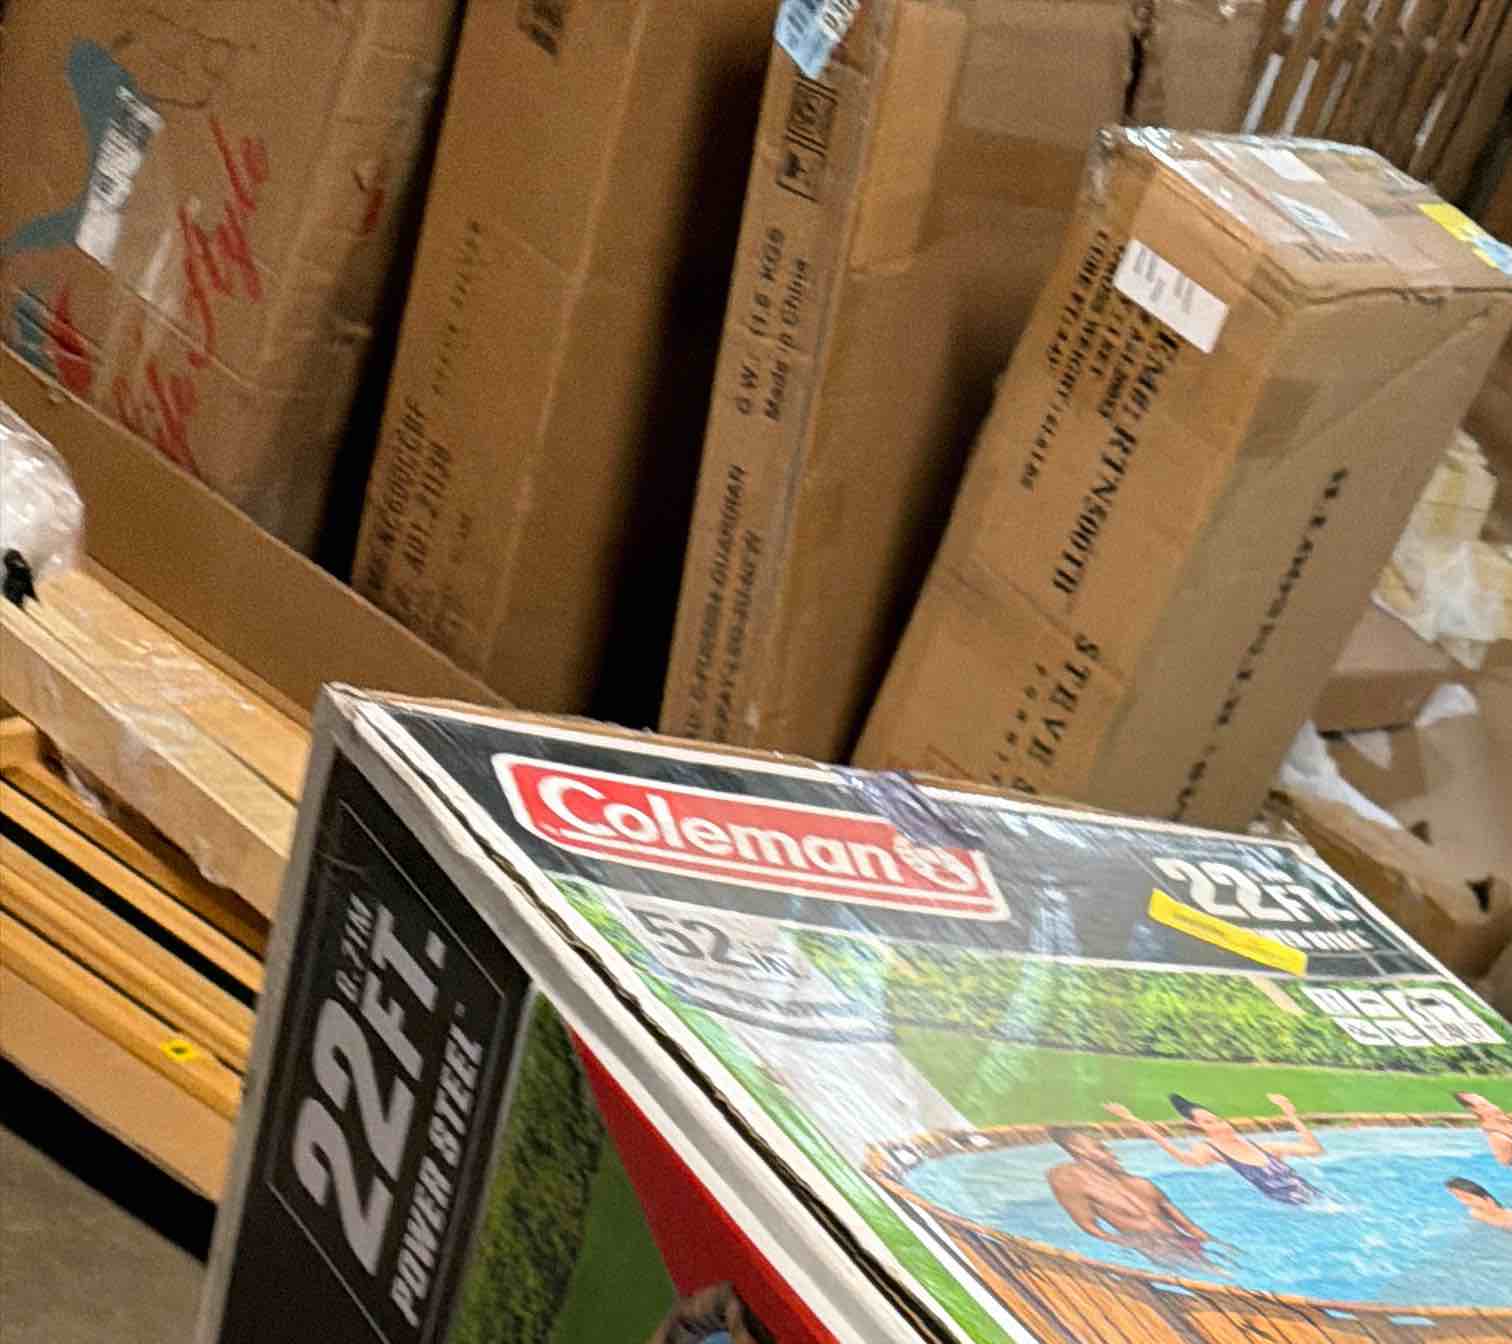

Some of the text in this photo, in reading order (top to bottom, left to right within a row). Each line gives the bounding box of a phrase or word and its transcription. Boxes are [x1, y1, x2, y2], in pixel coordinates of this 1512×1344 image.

[537, 776, 900, 883] Coleman
[644, 910, 755, 965] 52
[389, 1156, 455, 1328] POWER
